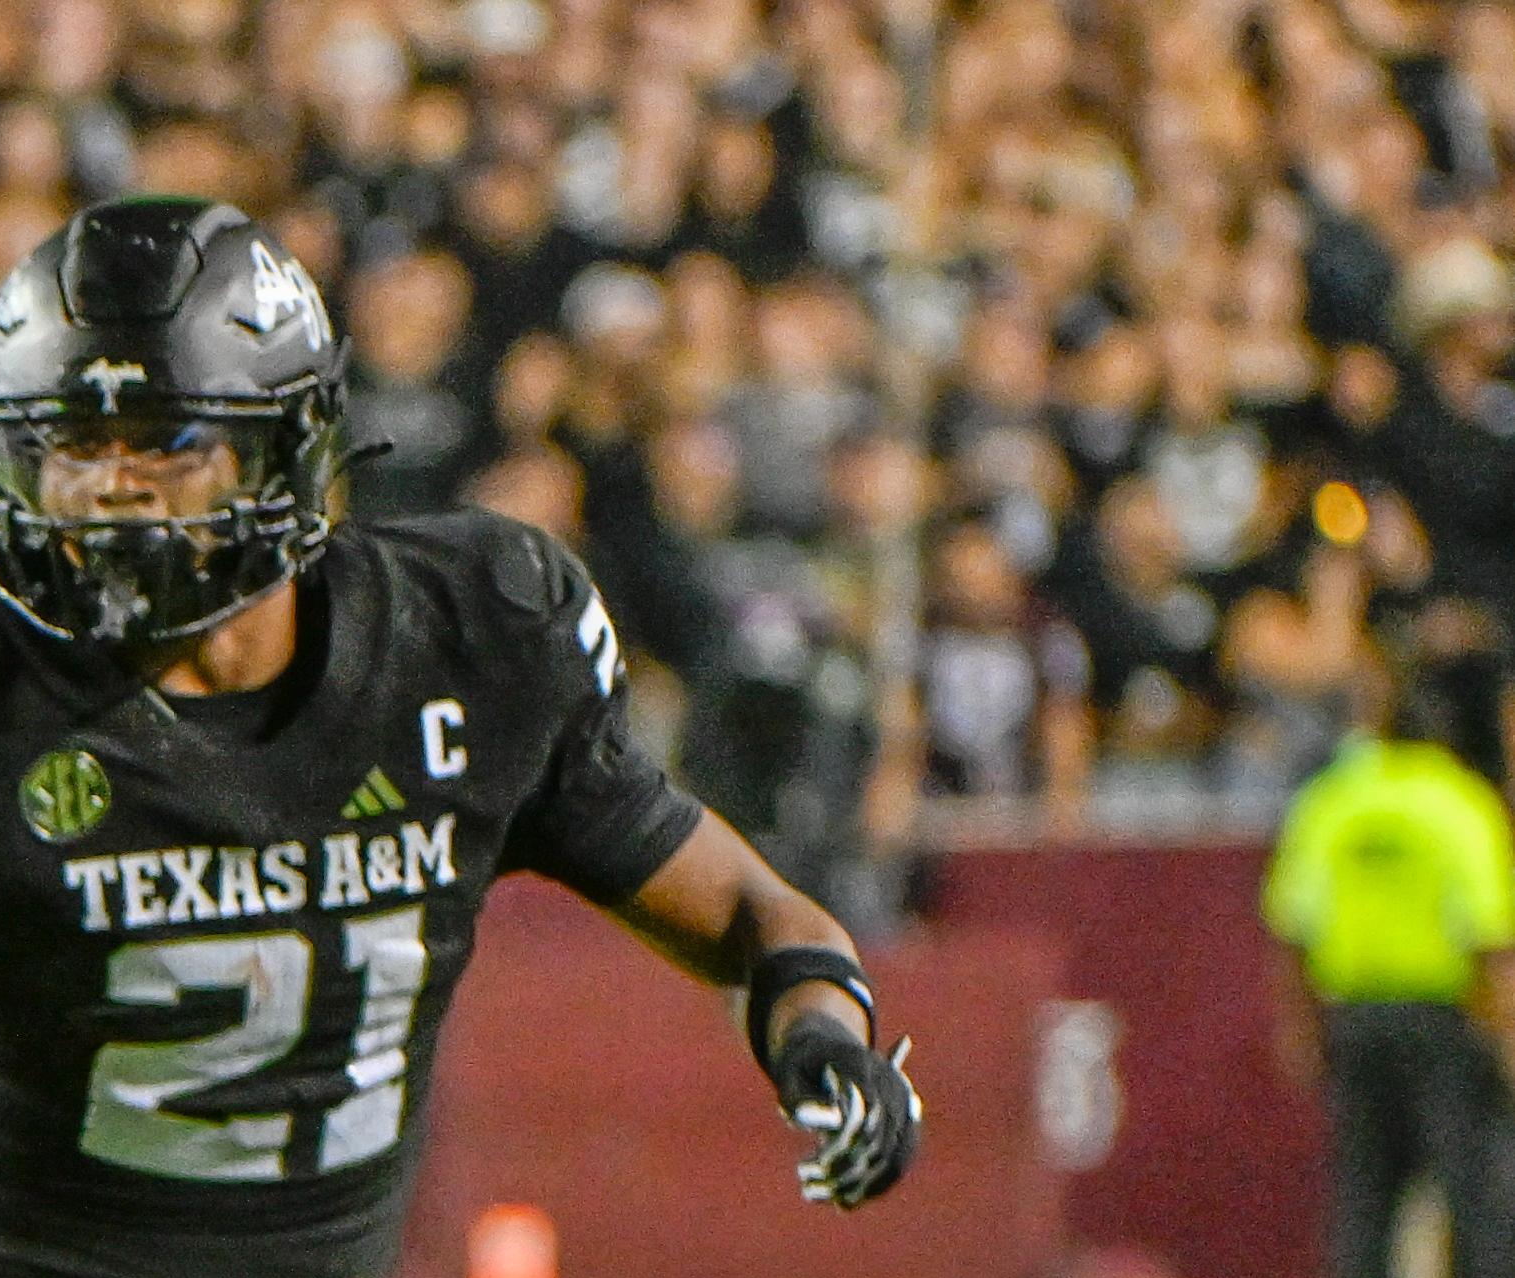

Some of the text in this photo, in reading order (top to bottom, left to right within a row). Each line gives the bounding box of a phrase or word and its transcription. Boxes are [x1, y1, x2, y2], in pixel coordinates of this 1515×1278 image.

[420, 697, 468, 780] C
[63, 812, 457, 932] TEXAS A&M
[78, 902, 428, 1182] 21
